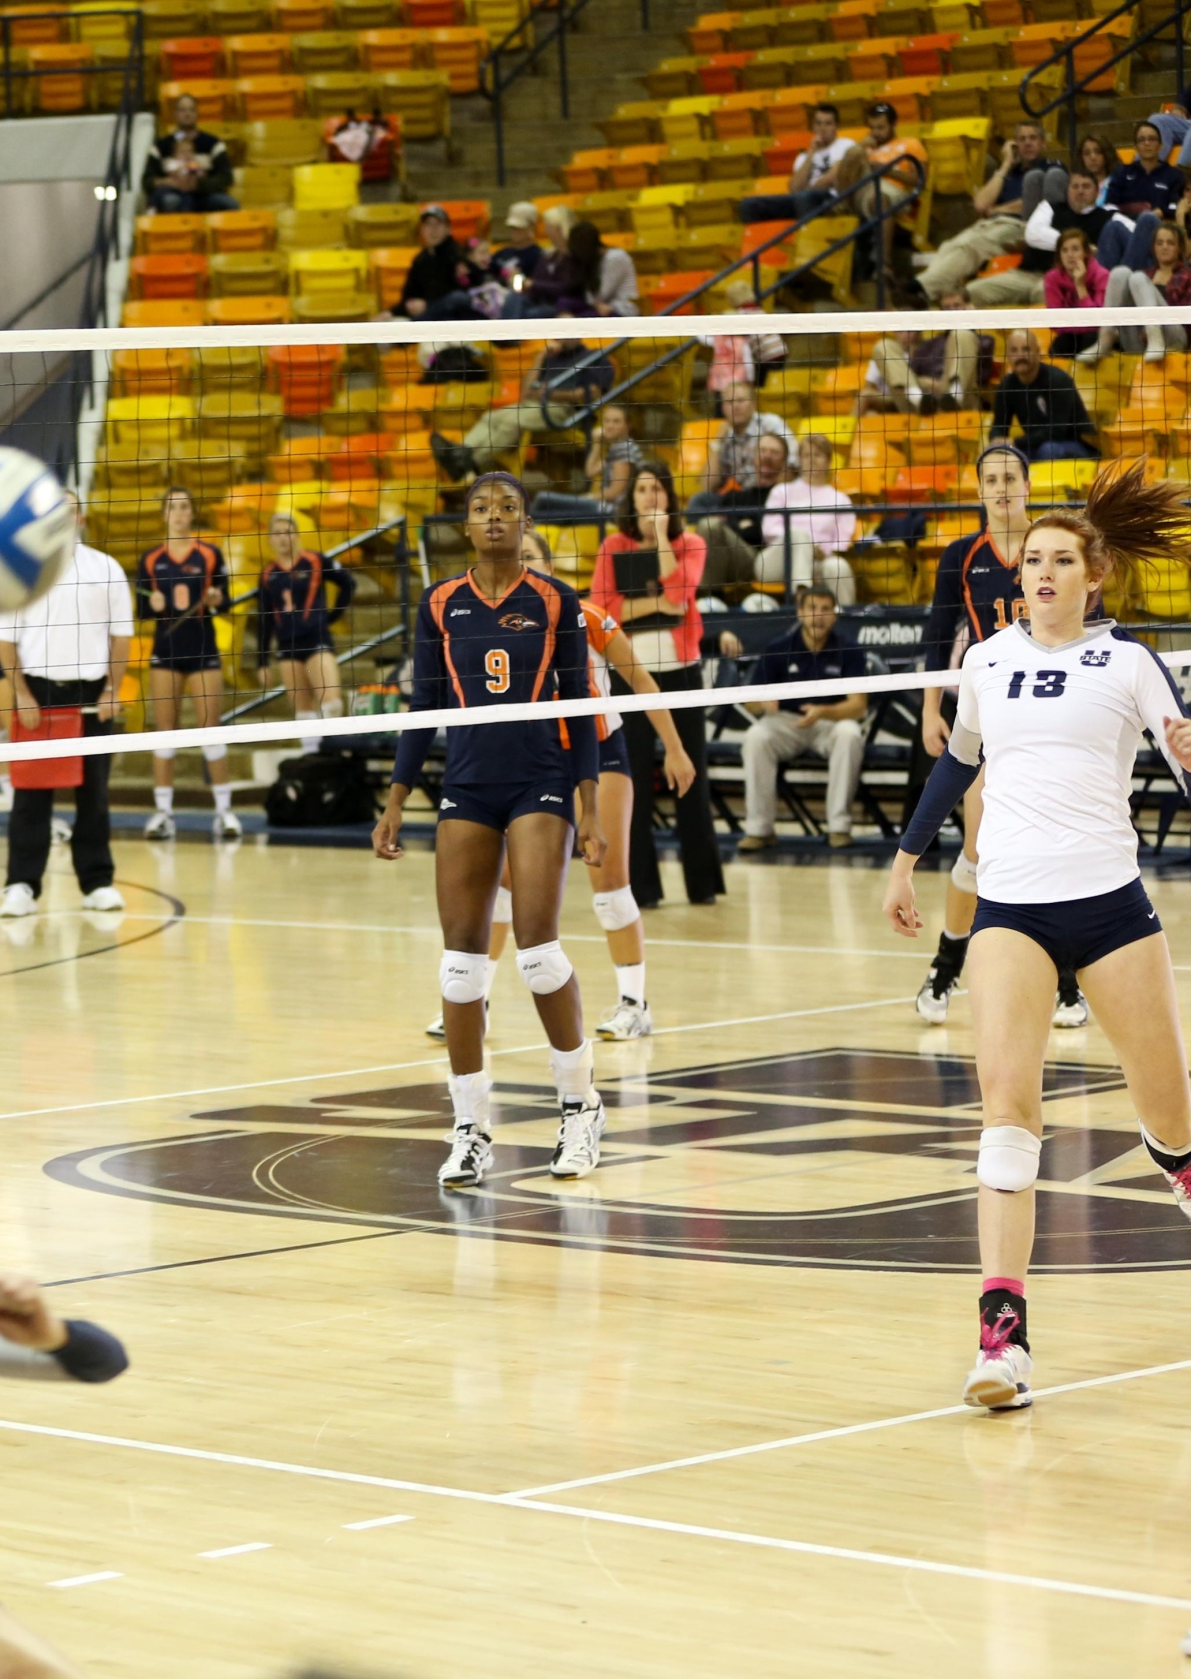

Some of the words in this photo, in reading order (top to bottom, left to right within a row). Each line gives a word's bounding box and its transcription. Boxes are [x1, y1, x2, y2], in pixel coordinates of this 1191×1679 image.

[857, 622, 923, 646] molten
[484, 648, 511, 694] 9
[1007, 669, 1067, 699] 13
